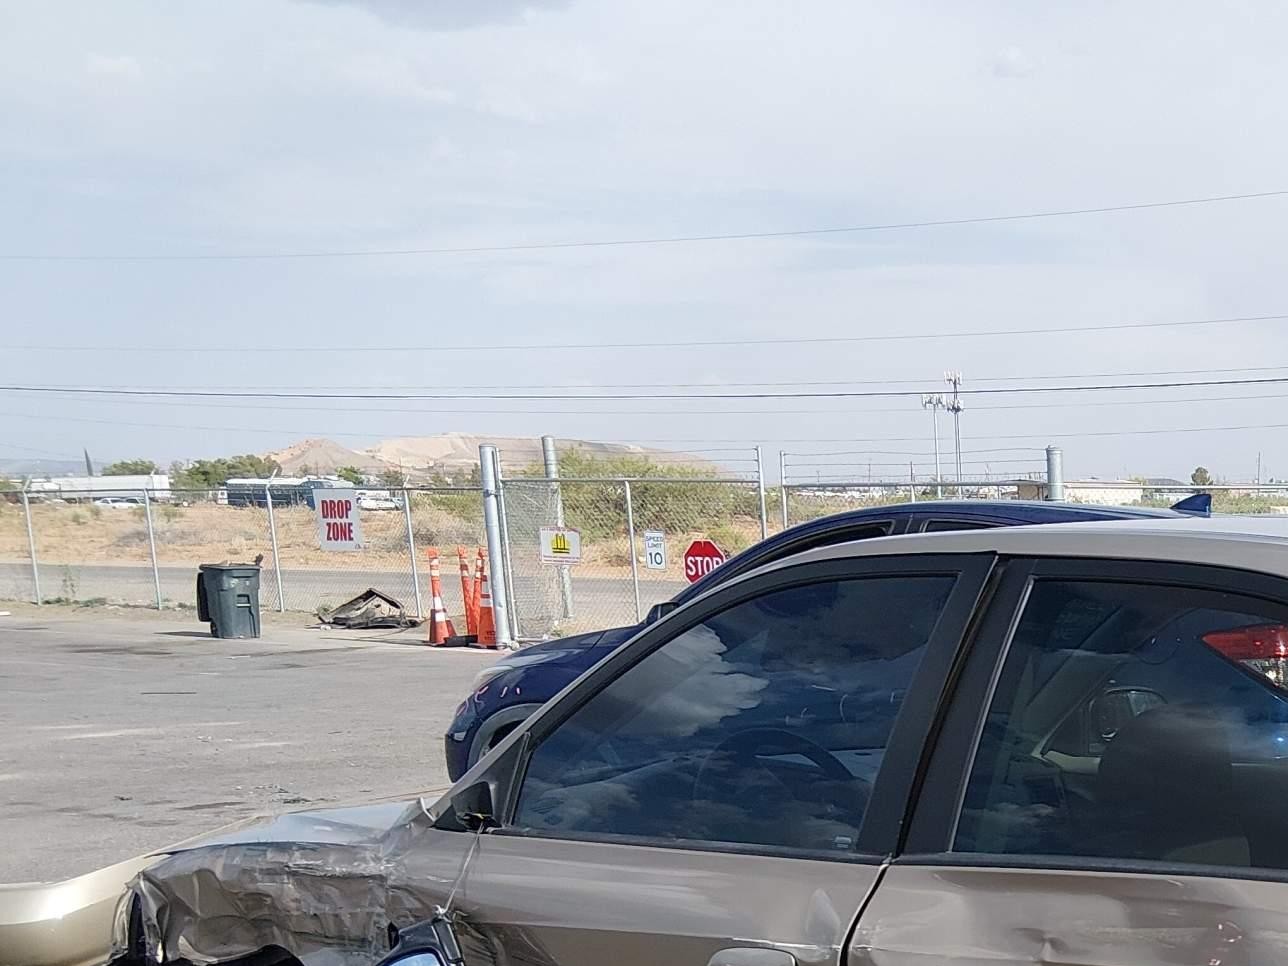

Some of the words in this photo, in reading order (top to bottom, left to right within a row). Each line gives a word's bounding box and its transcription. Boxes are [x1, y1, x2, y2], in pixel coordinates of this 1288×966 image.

[321, 500, 352, 519] DROP
[326, 522, 354, 541] ZONE
[648, 551, 663, 565] 10
